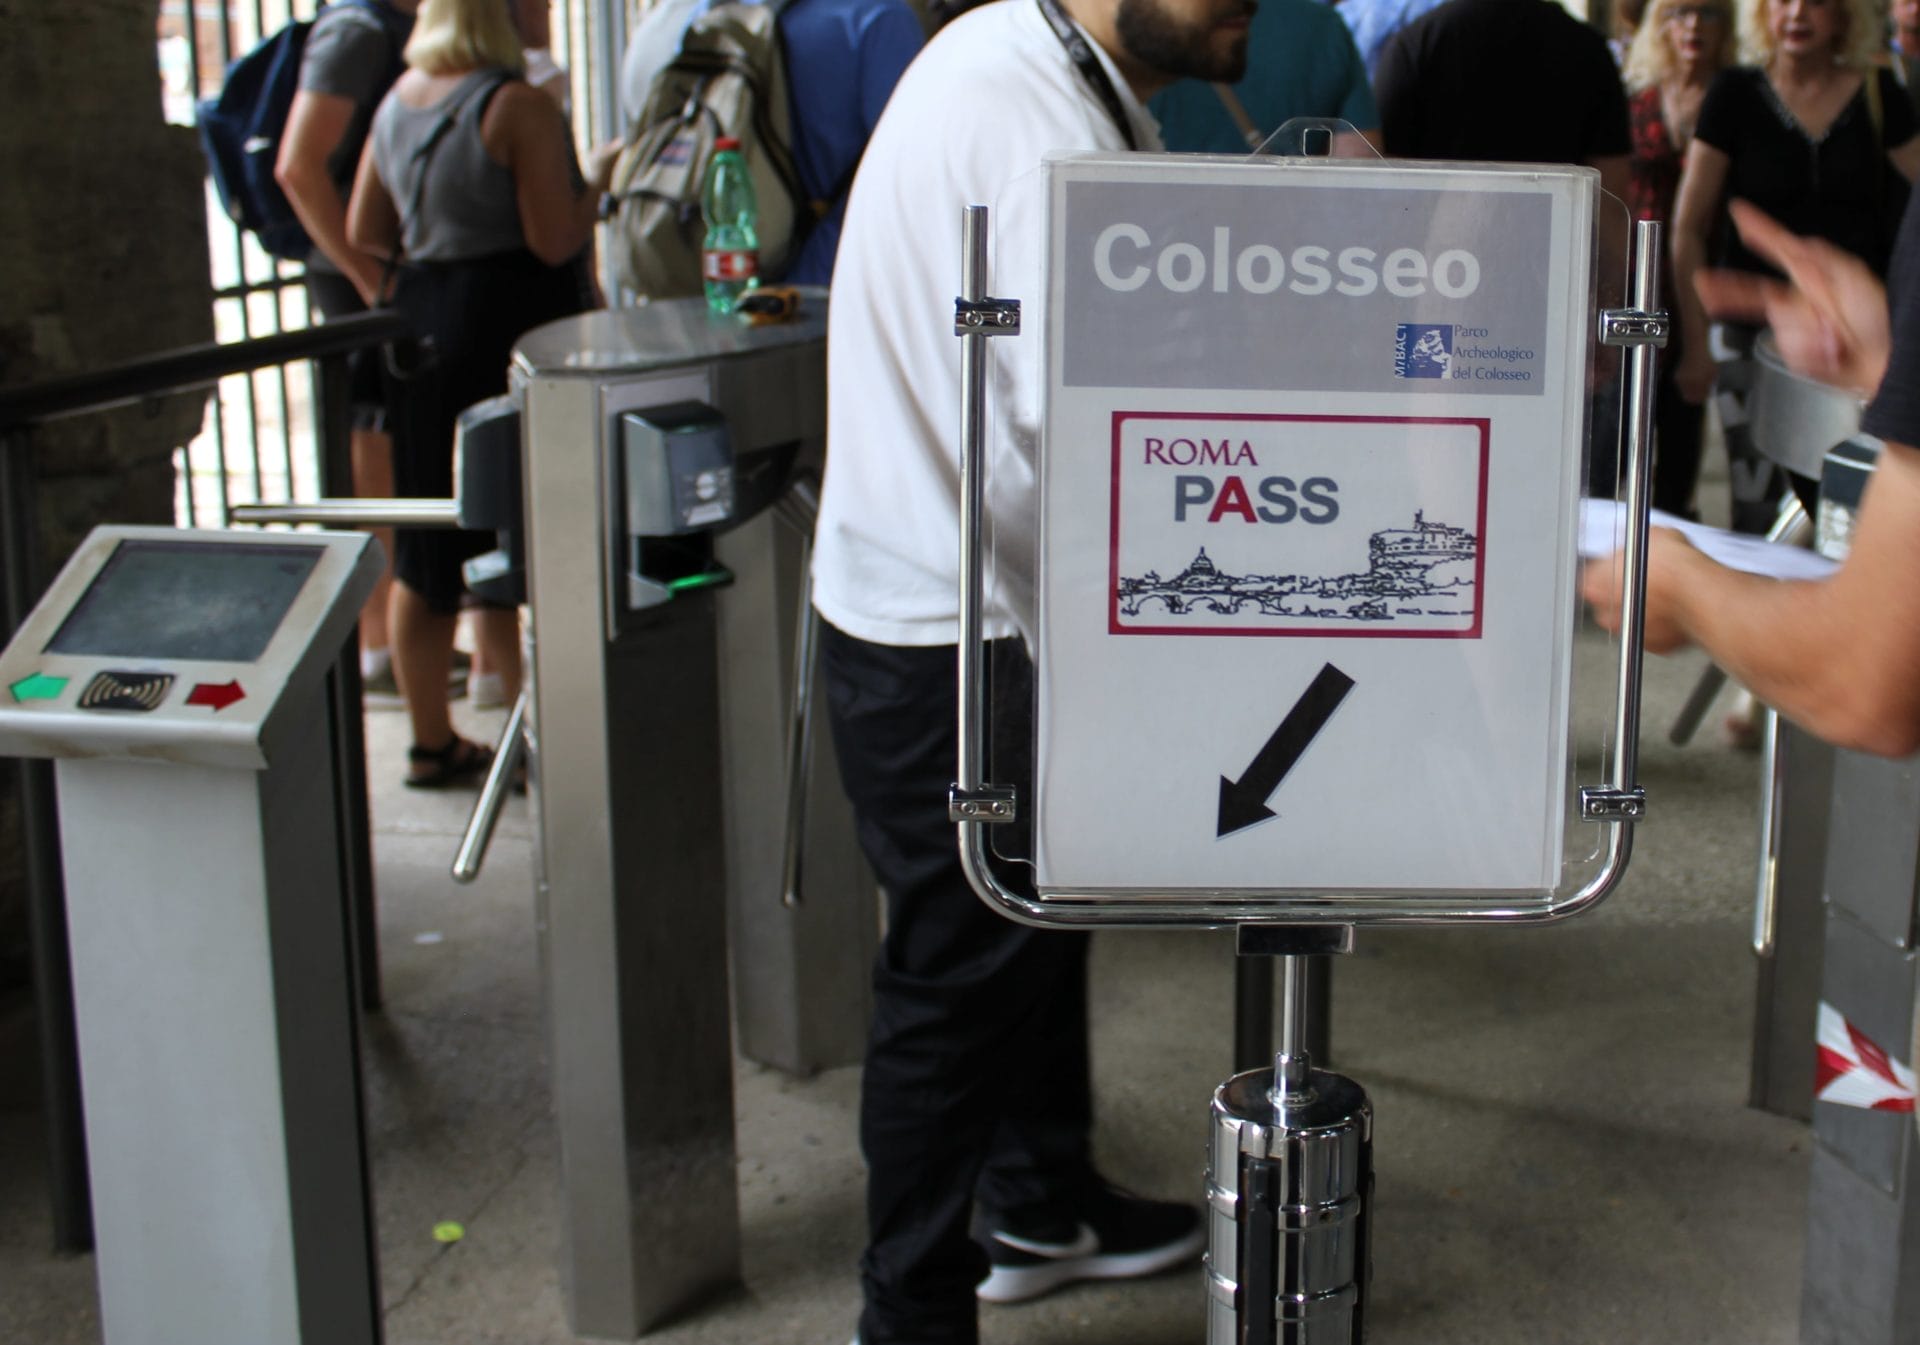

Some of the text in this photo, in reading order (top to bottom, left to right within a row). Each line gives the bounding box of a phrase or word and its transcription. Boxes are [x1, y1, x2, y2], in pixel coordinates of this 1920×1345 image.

[1093, 222, 1481, 299] Colosseo
[1454, 325, 1489, 337] Parco
[1453, 346, 1534, 362] Archeologico
[1453, 366, 1532, 380] del Colosseo
[1144, 438, 1259, 467] ROMA
[1174, 475, 1340, 525] PASS
